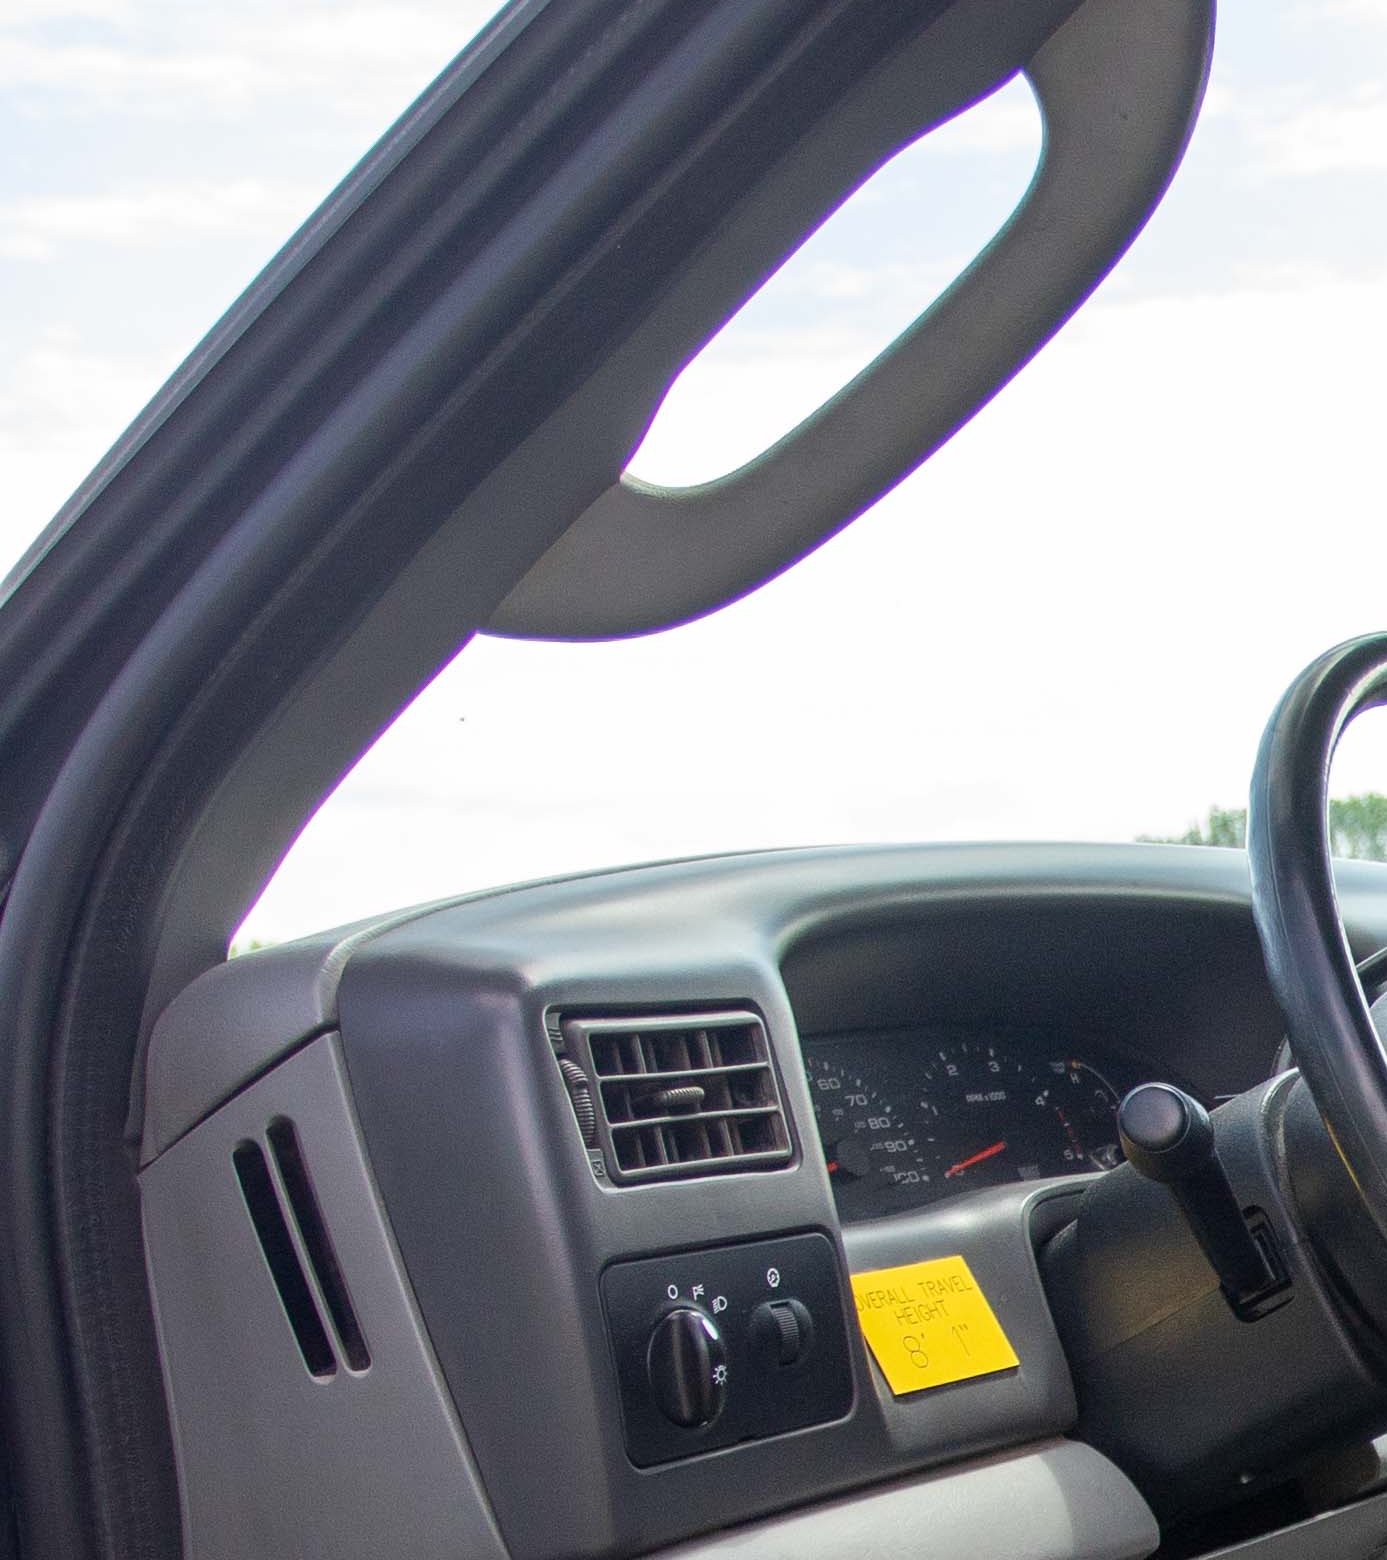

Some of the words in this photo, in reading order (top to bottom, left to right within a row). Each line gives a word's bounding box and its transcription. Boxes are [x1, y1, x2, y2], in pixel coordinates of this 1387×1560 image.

[988, 1061, 1001, 1073] 3
[817, 1077, 841, 1091] 60
[845, 1094, 868, 1107] 70
[867, 1117, 891, 1130] 80
[884, 1140, 908, 1153] 90
[856, 1287, 915, 1312] OVERALL
[917, 1275, 973, 1298] TRAVEL
[894, 1299, 950, 1326] HEIGHT
